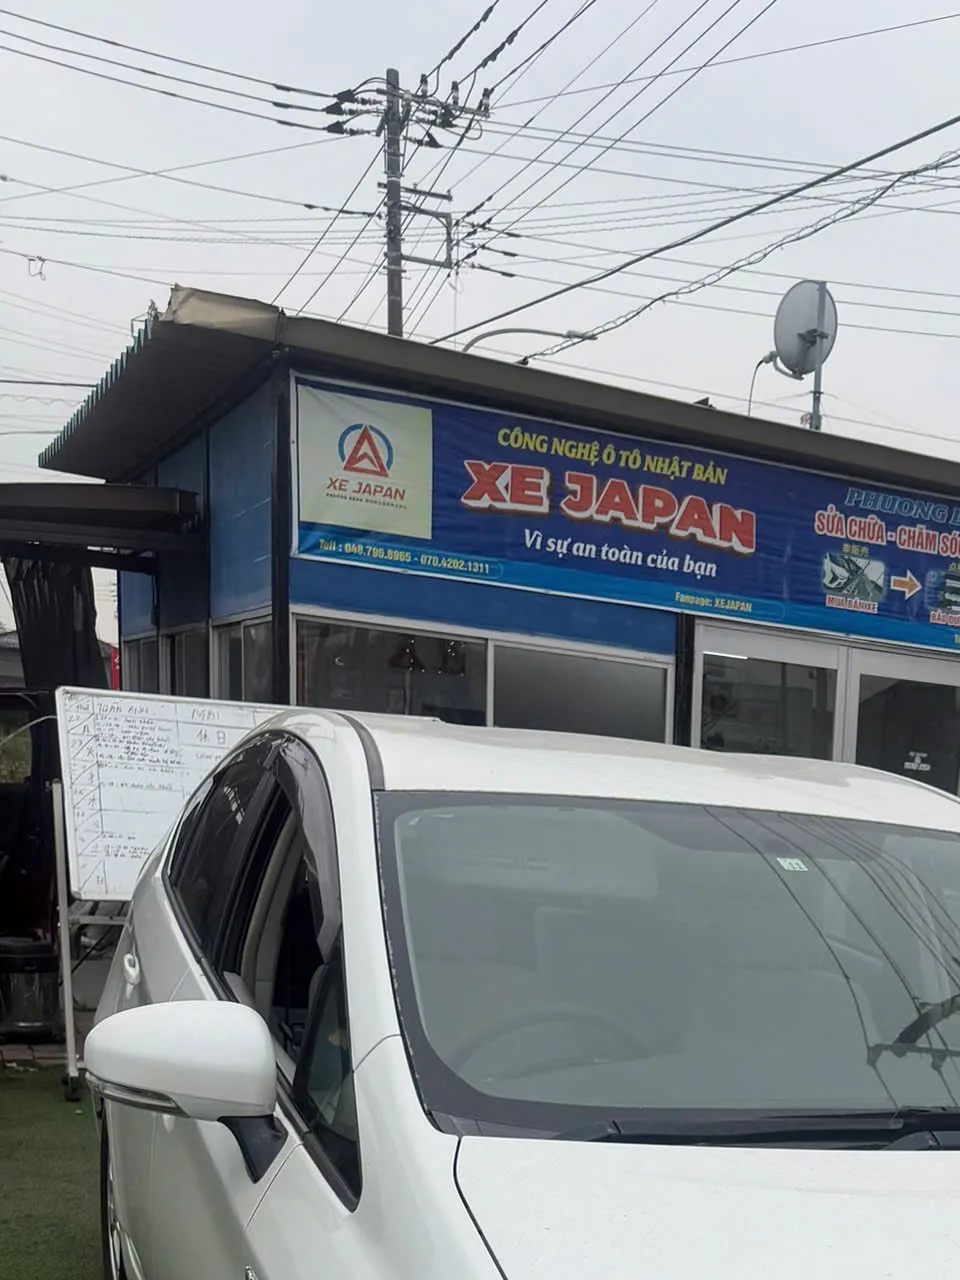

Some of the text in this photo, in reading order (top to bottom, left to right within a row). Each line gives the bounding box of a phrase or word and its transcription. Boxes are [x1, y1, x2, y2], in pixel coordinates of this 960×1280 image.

[498, 427, 728, 485] CÔNG NGHỆ Ô TÔ NHẬT BẢN
[326, 477, 349, 492] XE
[352, 481, 406, 501] JAPAN
[461, 460, 756, 553] XE JAPAN
[815, 504, 846, 538] SỬA
[847, 514, 886, 545] CHỮA
[897, 524, 938, 554] CHĂM
[546, 537, 572, 558] sự
[572, 542, 597, 558] an
[600, 543, 643, 565] toàn
[647, 549, 679, 571] của
[683, 554, 717, 579] bạn
